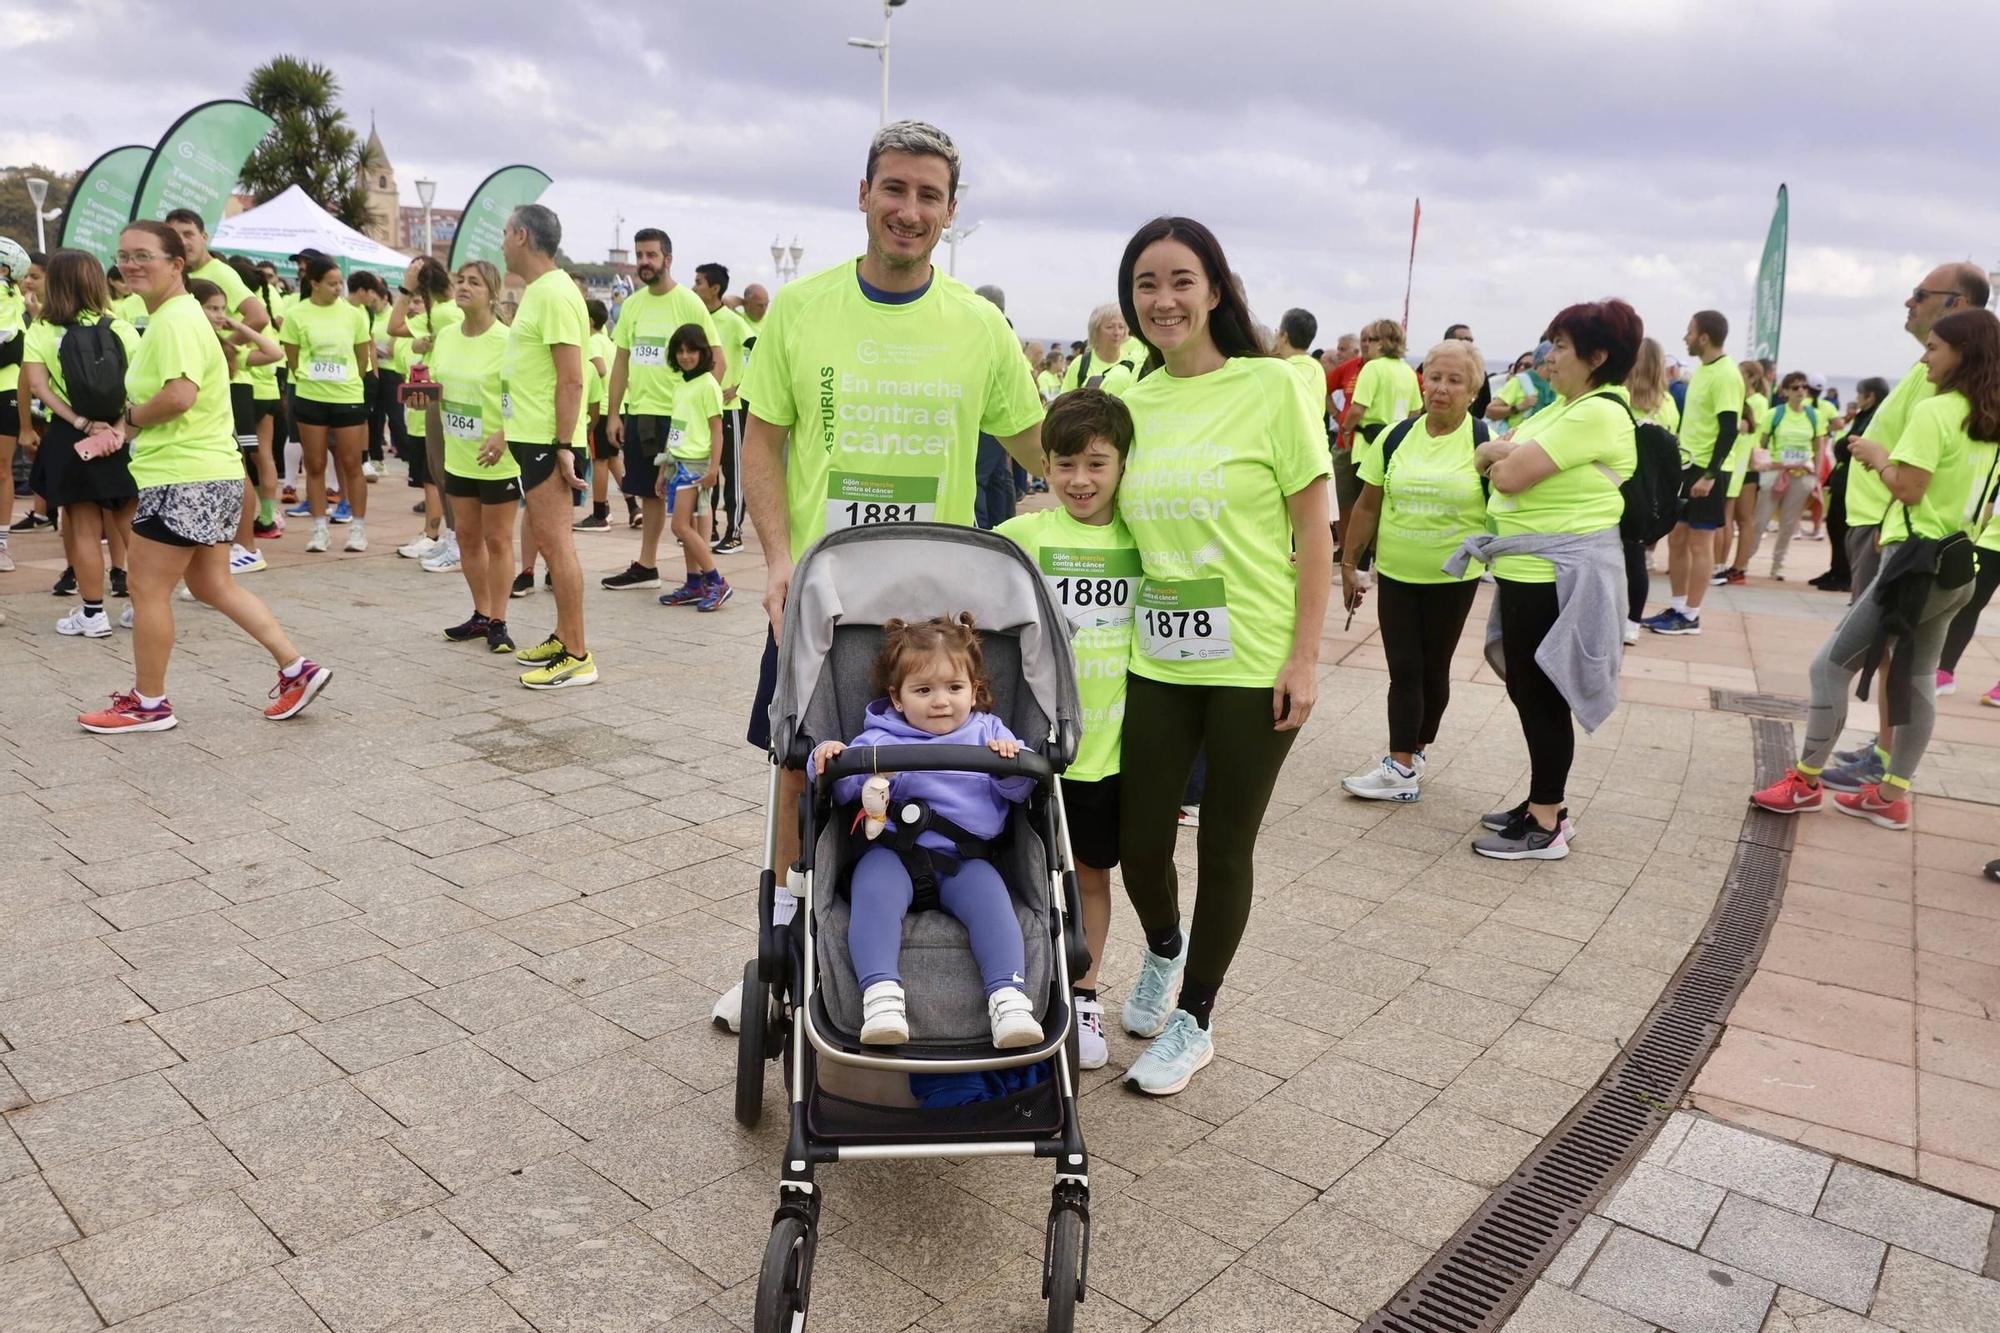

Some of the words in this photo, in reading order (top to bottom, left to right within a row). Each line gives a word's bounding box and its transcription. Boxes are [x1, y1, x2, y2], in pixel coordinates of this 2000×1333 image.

[167, 178, 182, 191] un
[636, 346, 659, 358] 1394
[314, 363, 341, 374] 0781
[841, 371, 869, 393] En
[876, 377, 963, 399] marcha
[447, 413, 475, 431] 1264
[820, 366, 835, 455] ASTURIAS
[839, 401, 930, 425] contra
[934, 403, 957, 427] el
[839, 425, 955, 456] cáncer
[842, 478, 860, 487] Gijón
[1197, 463, 1226, 490] el
[845, 502, 916, 526] 1881
[1053, 553, 1070, 561] Gijón
[1056, 578, 1128, 607] 1880
[1145, 609, 1212, 638] 1878
